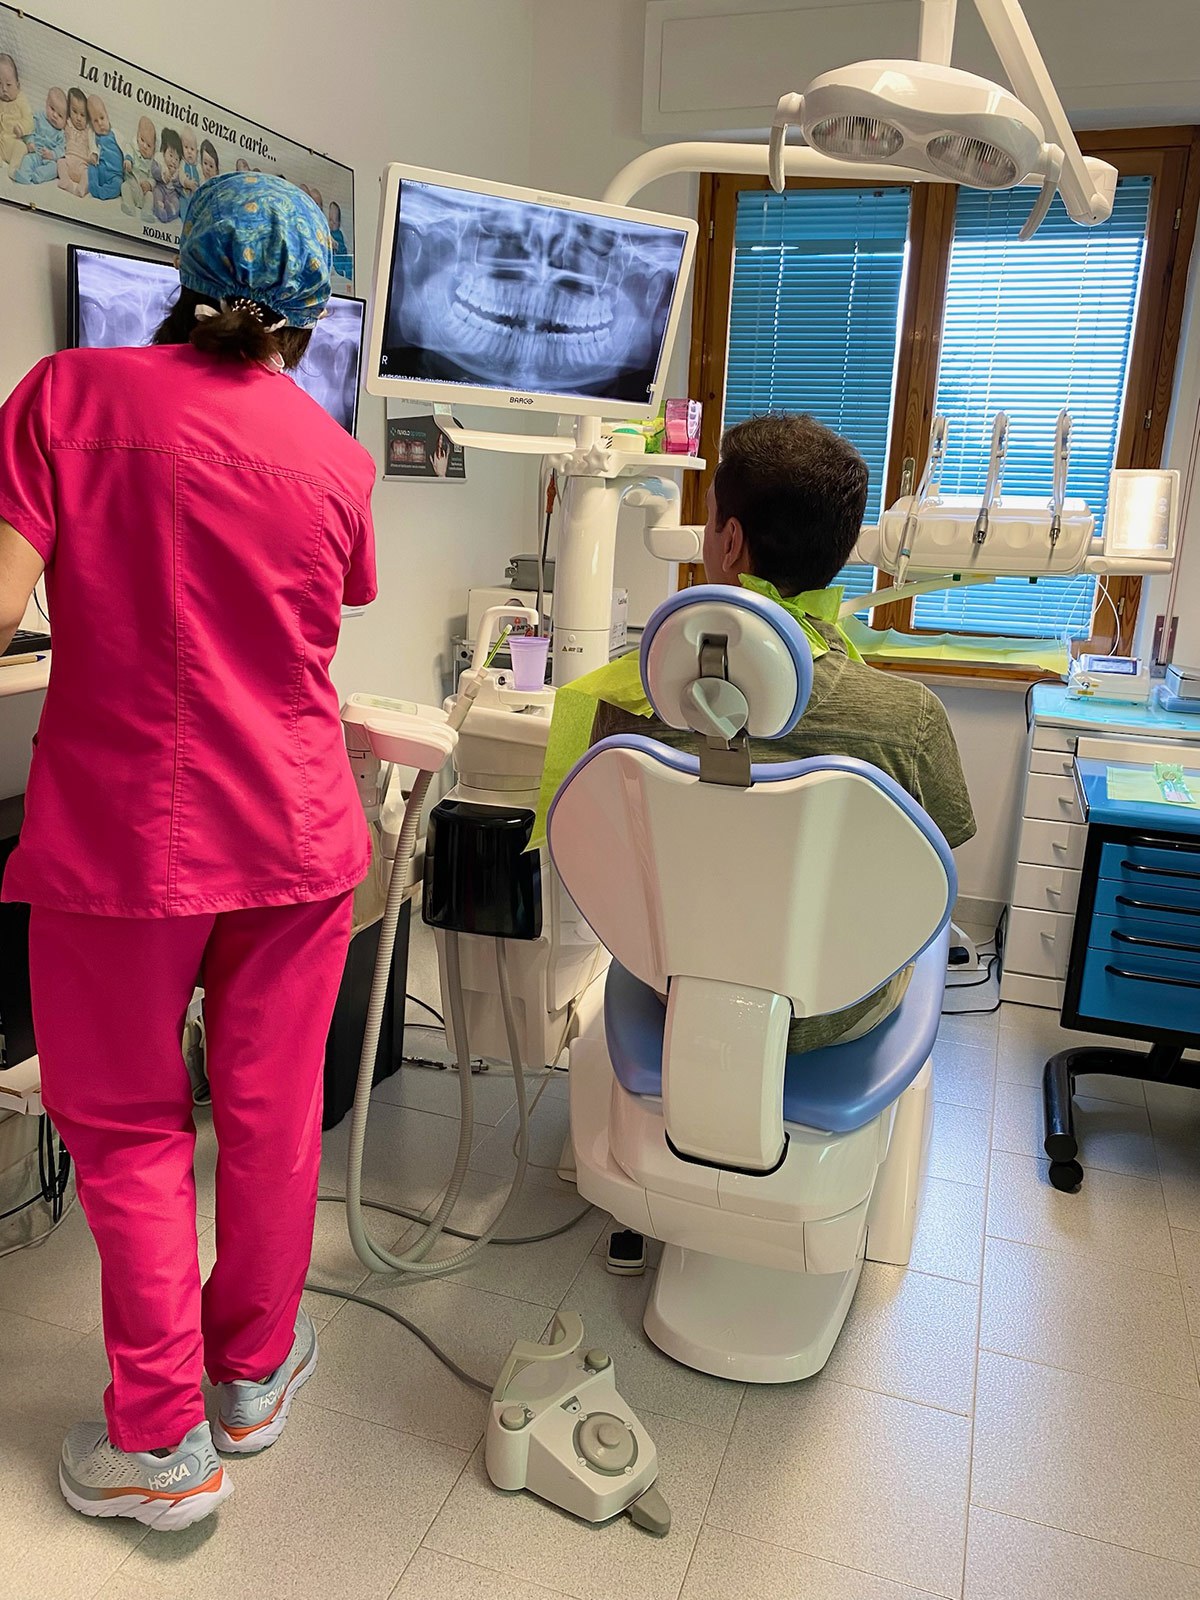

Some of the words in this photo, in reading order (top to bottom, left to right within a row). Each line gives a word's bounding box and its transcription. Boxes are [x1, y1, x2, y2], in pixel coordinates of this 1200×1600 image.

[79, 56, 99, 83] La
[103, 70, 132, 98] vita
[137, 88, 199, 127] comincia
[202, 116, 236, 143] senza
[240, 134, 277, 162] carie...
[143, 225, 172, 243] KODAK
[382, 355, 389, 365] R
[510, 396, 534, 405] BARCO
[148, 1463, 191, 1491] HOKA
